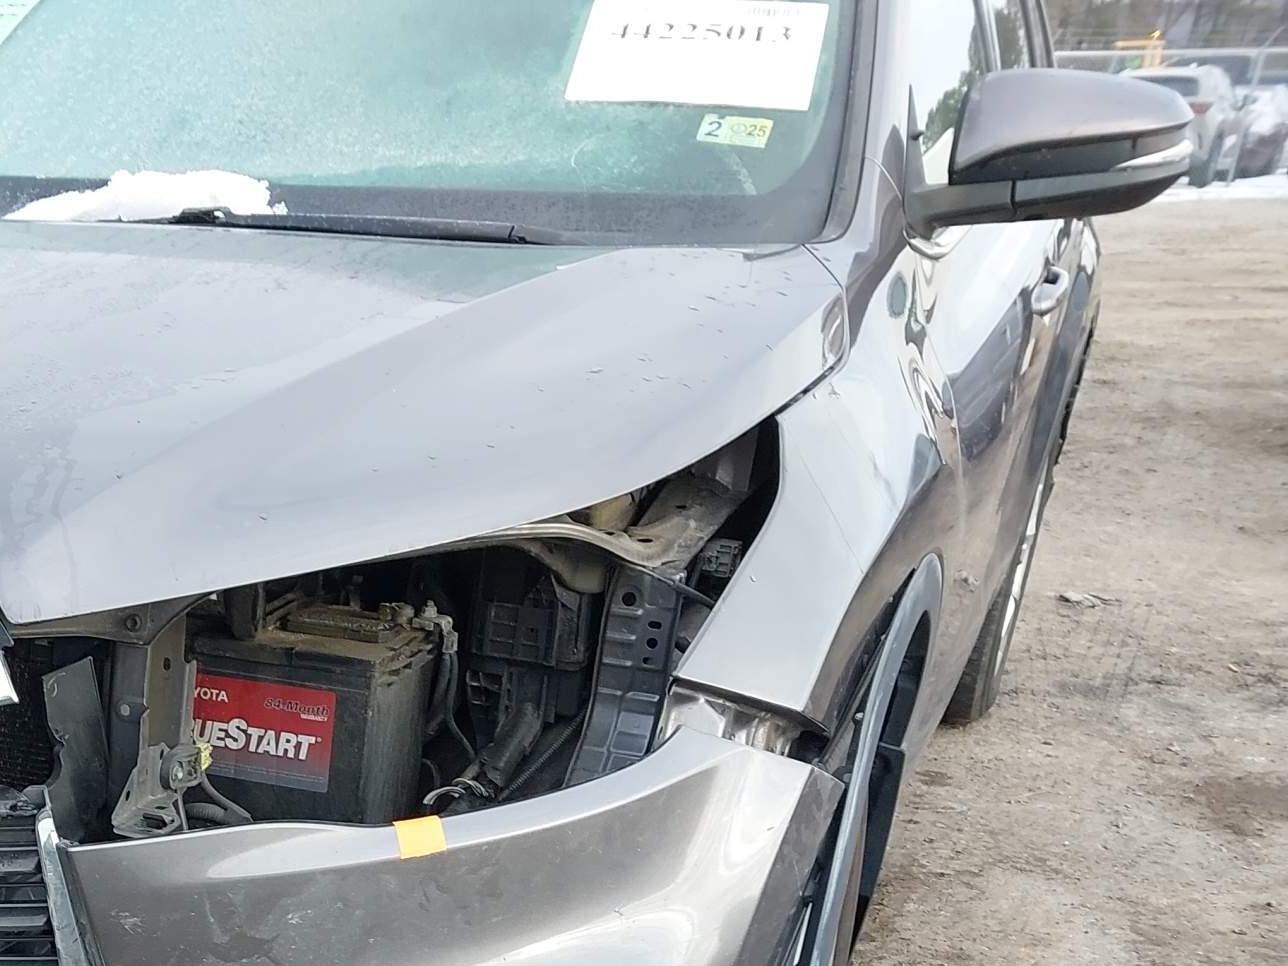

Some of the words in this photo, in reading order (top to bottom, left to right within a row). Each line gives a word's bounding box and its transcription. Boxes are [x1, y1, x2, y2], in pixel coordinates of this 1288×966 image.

[611, 22, 793, 43] 44225013
[703, 120, 722, 138] 2
[746, 124, 768, 138] 25
[194, 686, 229, 703] YOTA
